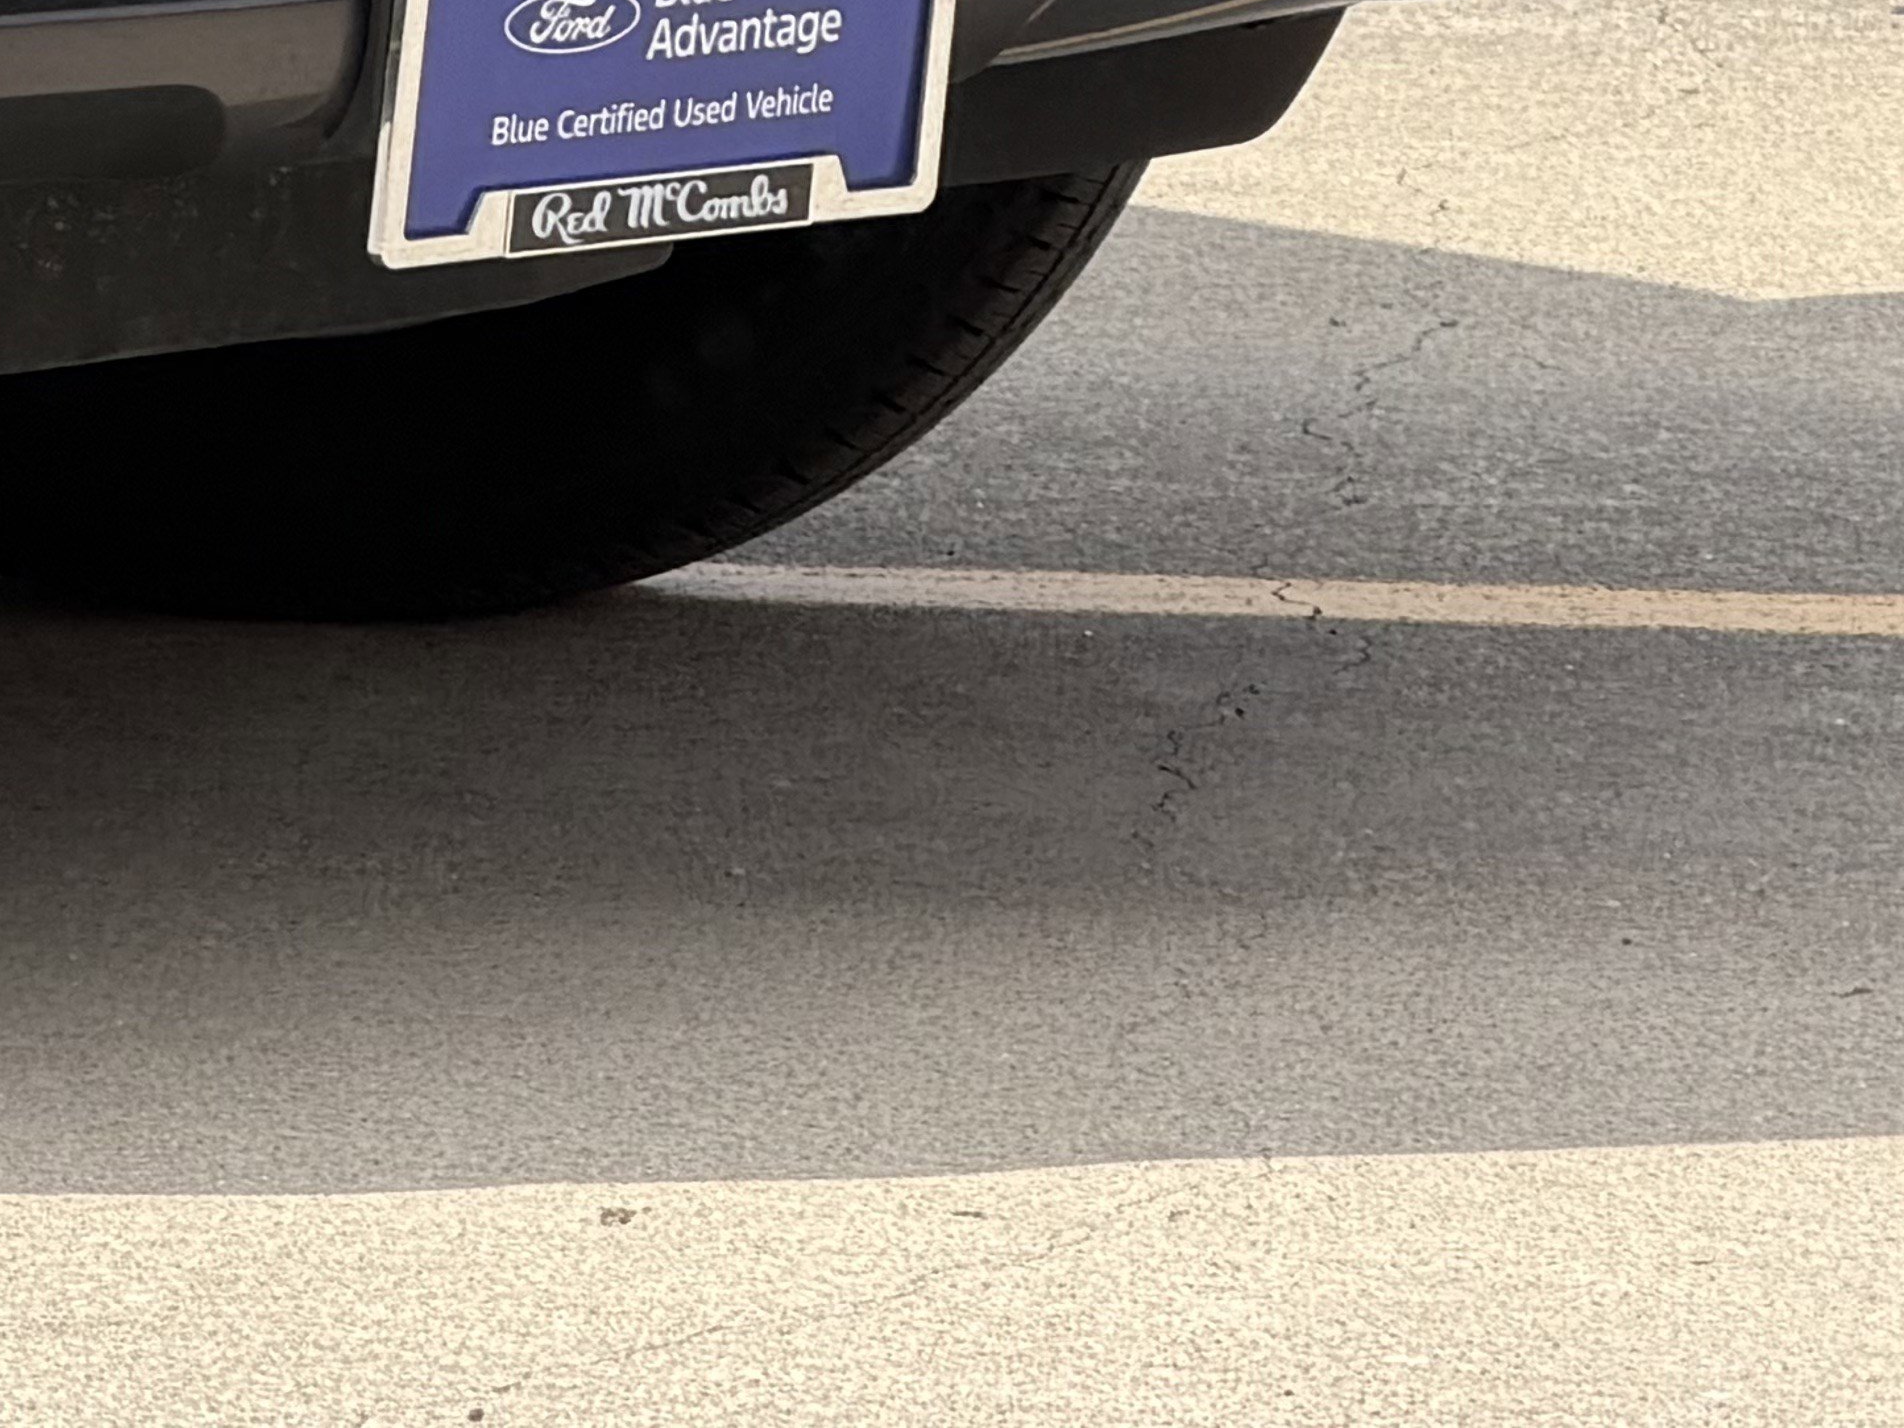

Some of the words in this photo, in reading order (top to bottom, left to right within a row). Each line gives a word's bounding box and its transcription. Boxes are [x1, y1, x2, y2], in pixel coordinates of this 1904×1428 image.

[645, 7, 843, 61] Advantage
[491, 115, 549, 147] Blue
[557, 99, 666, 140] Certified
[673, 92, 738, 129] Used
[745, 82, 834, 120] Vehicle
[531, 189, 612, 245] Red
[617, 173, 789, 231] McCombs
